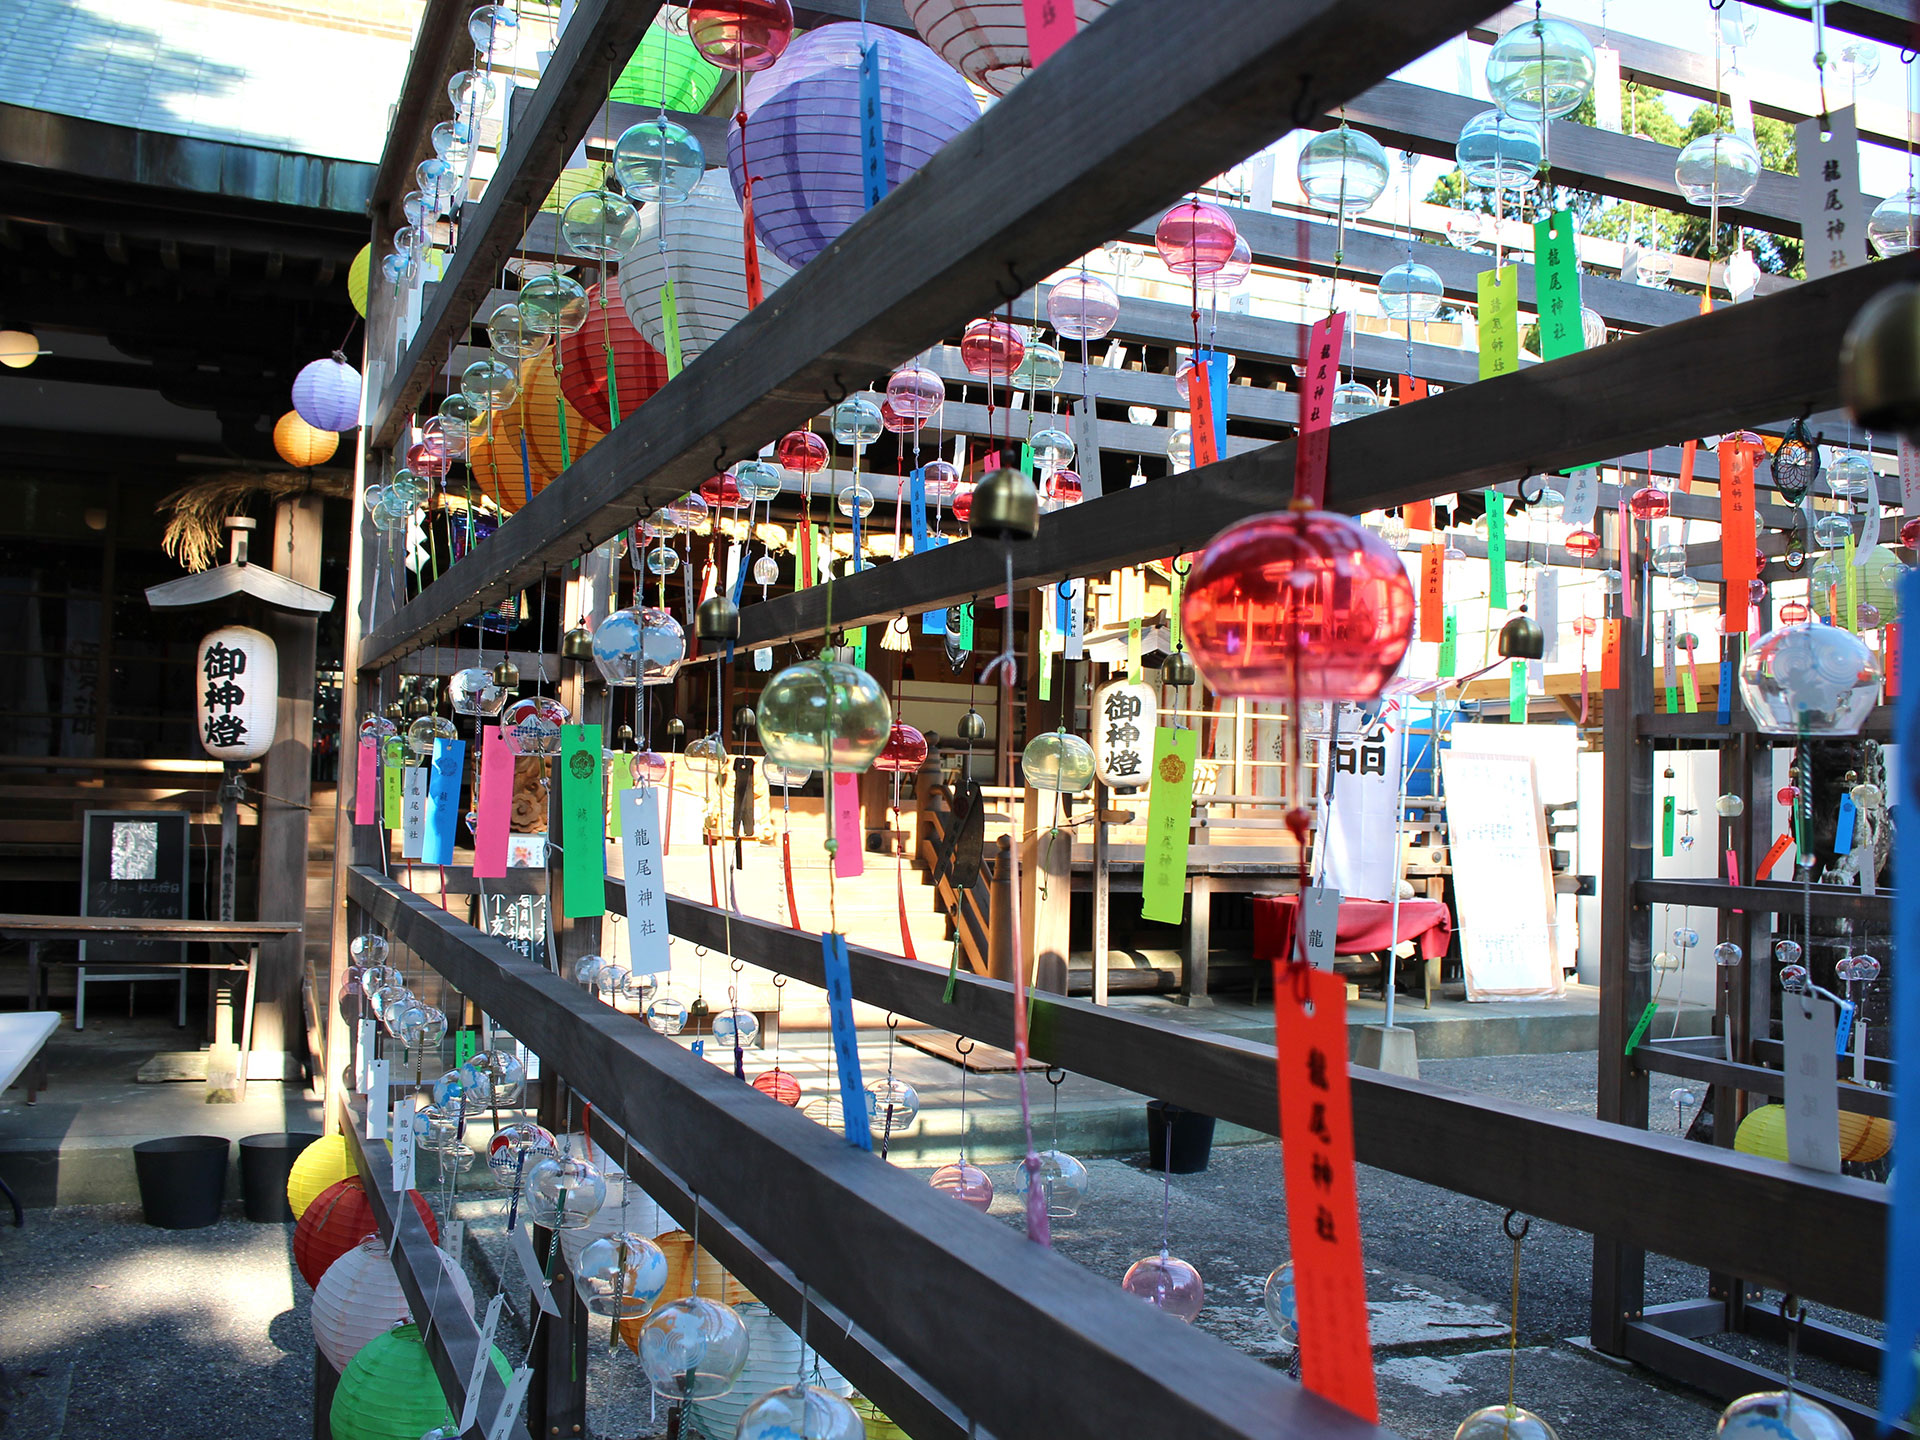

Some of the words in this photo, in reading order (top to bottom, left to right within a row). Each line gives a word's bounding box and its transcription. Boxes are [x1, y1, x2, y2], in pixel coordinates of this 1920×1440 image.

[1821, 158, 1849, 269] 龍尾神社
[1547, 247, 1567, 341] 龍尾神社
[1310, 343, 1331, 422] 龍尾神社
[1428, 557, 1439, 595] 龍尾神社
[203, 641, 247, 748] 御神燈
[1104, 690, 1142, 777] 御神燈
[408, 786, 421, 840] 龍尾神社
[1156, 815, 1178, 888] 龍尾神社
[634, 827, 658, 937] 龍尾神社
[399, 1119, 410, 1173] 龍尾神社
[1307, 1045, 1339, 1246] 龍尾神社
[470, 1325, 492, 1404] 龍尾神社
